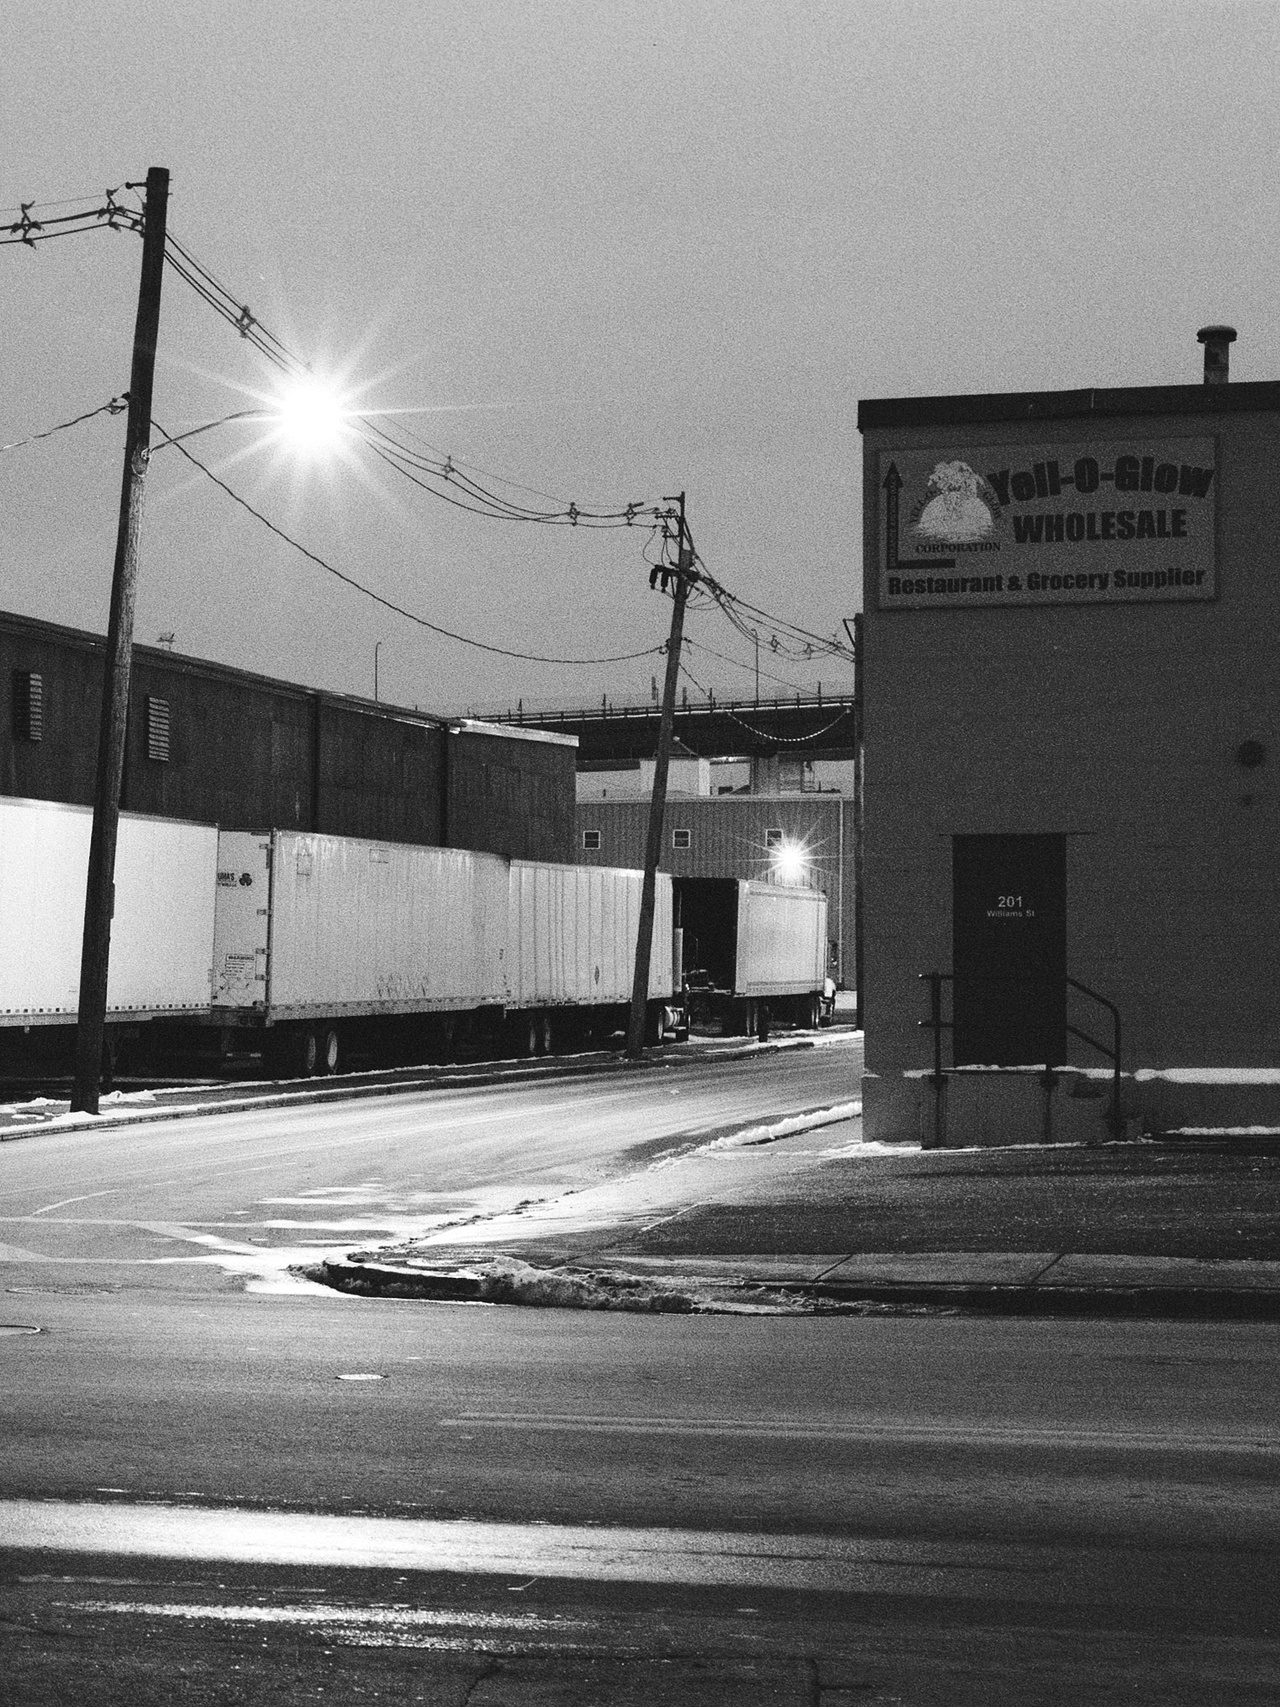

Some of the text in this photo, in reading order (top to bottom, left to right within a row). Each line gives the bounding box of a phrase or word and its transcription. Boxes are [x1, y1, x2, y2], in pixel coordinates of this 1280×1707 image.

[986, 455, 1215, 506] Yell-O-Glow
[1013, 509, 1187, 543] WHOLESALE
[915, 541, 1001, 554] CORPORATION
[888, 567, 1206, 595] Restaurant & Grocery Supplier
[998, 895, 1022, 907] 201
[986, 909, 1035, 918] Williams St
